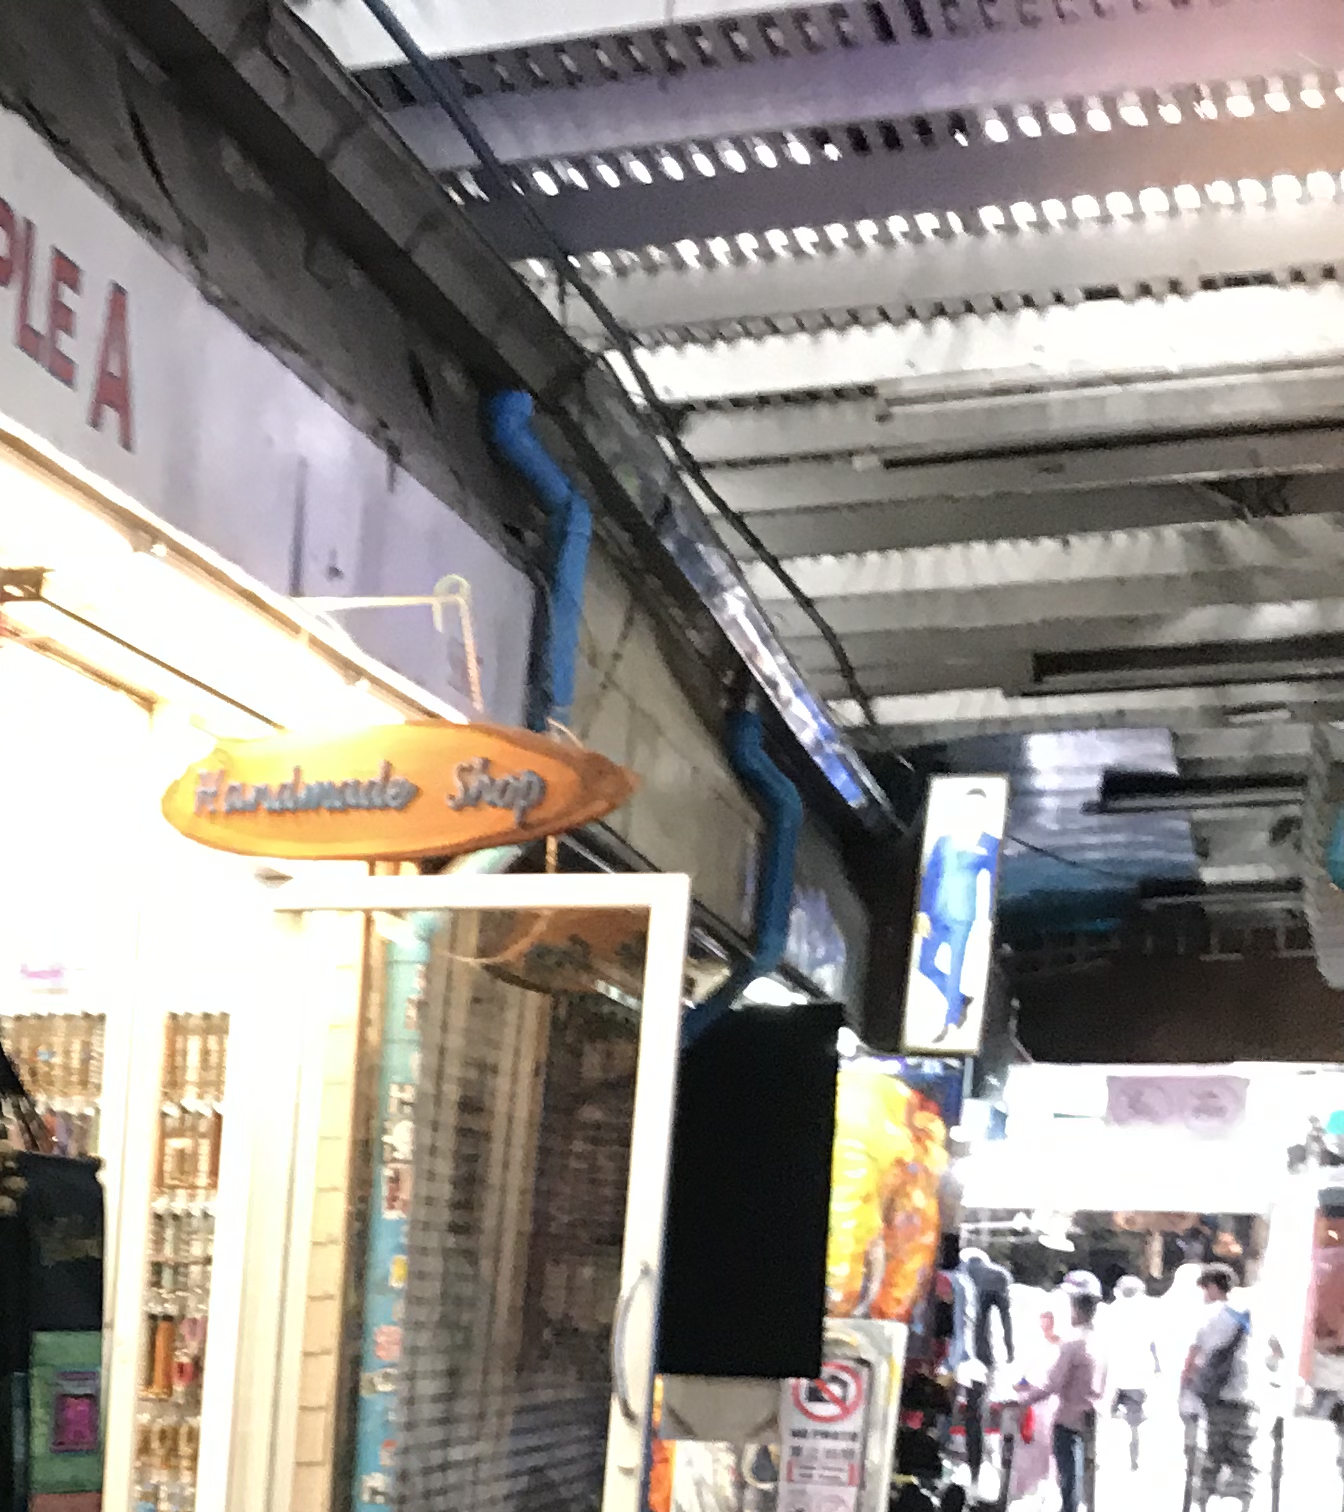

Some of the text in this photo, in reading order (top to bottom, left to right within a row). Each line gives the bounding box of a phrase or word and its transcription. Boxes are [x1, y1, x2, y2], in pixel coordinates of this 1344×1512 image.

[86, 279, 135, 453] A
[193, 756, 548, 828] Handmade Shop
